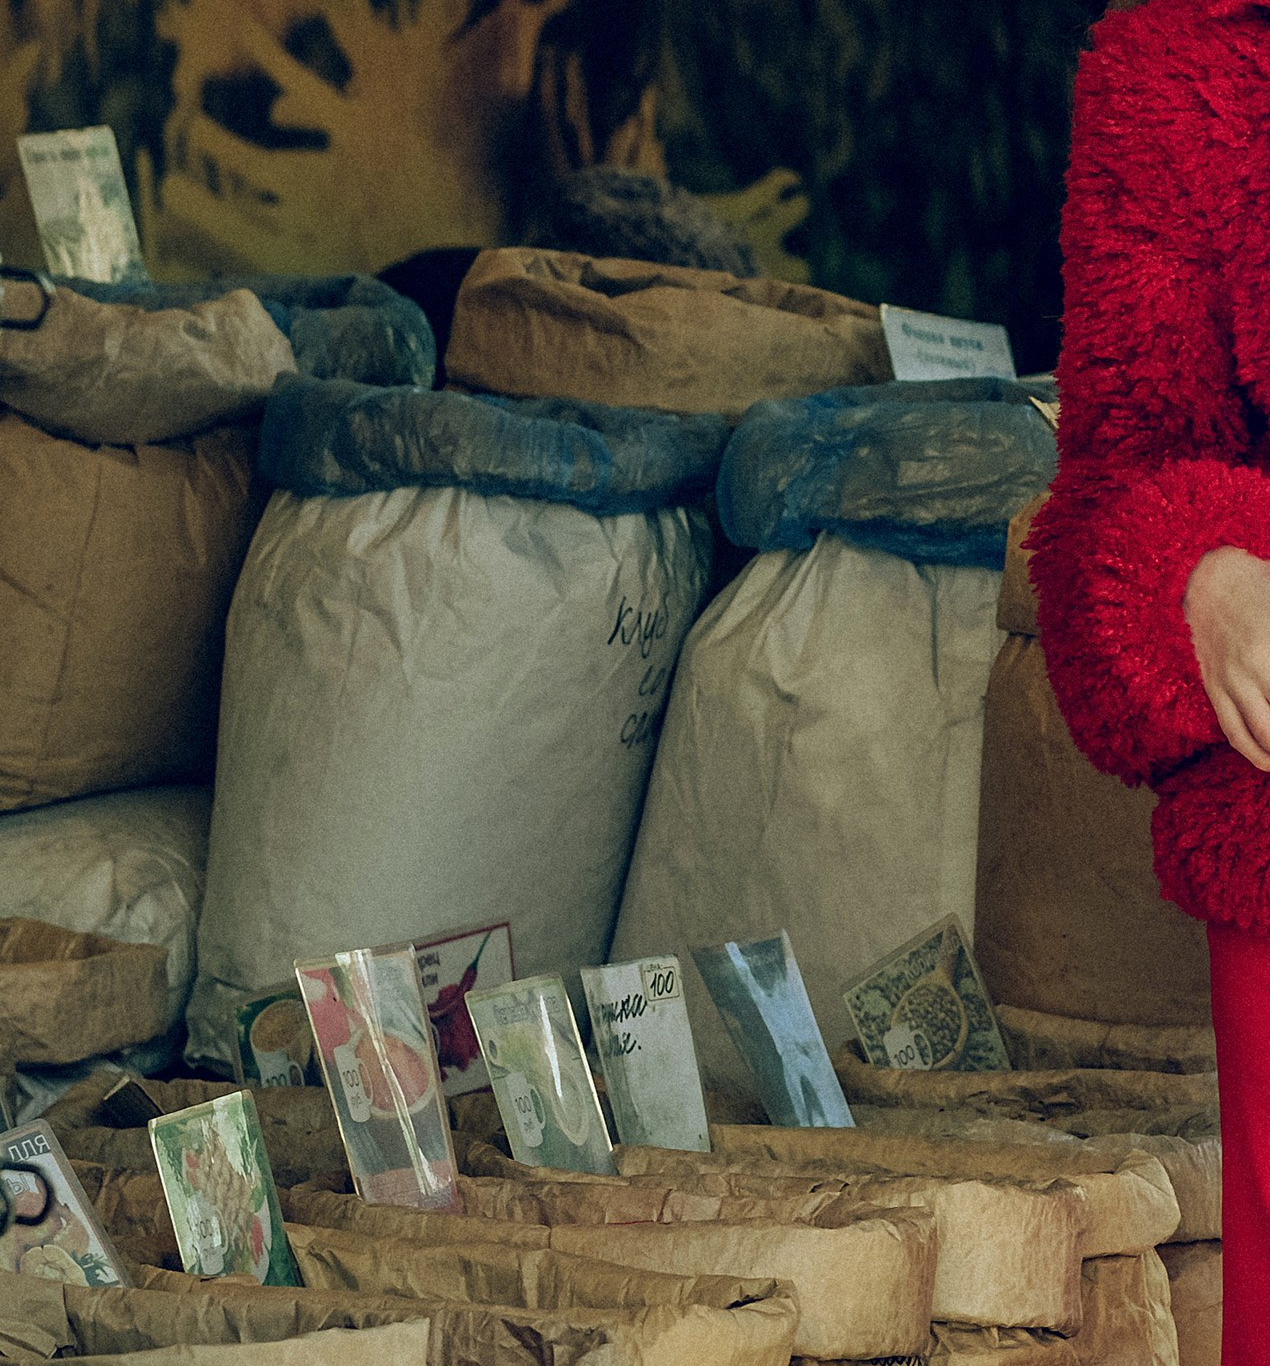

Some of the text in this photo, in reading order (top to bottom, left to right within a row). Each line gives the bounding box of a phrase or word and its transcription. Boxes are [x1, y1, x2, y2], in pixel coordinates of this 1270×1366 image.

[650, 971, 675, 998] 100
[895, 1043, 915, 1063] 100
[342, 1068, 360, 1088] 100
[514, 1095, 533, 1114] 100
[8, 1134, 51, 1163] ДЛЯ
